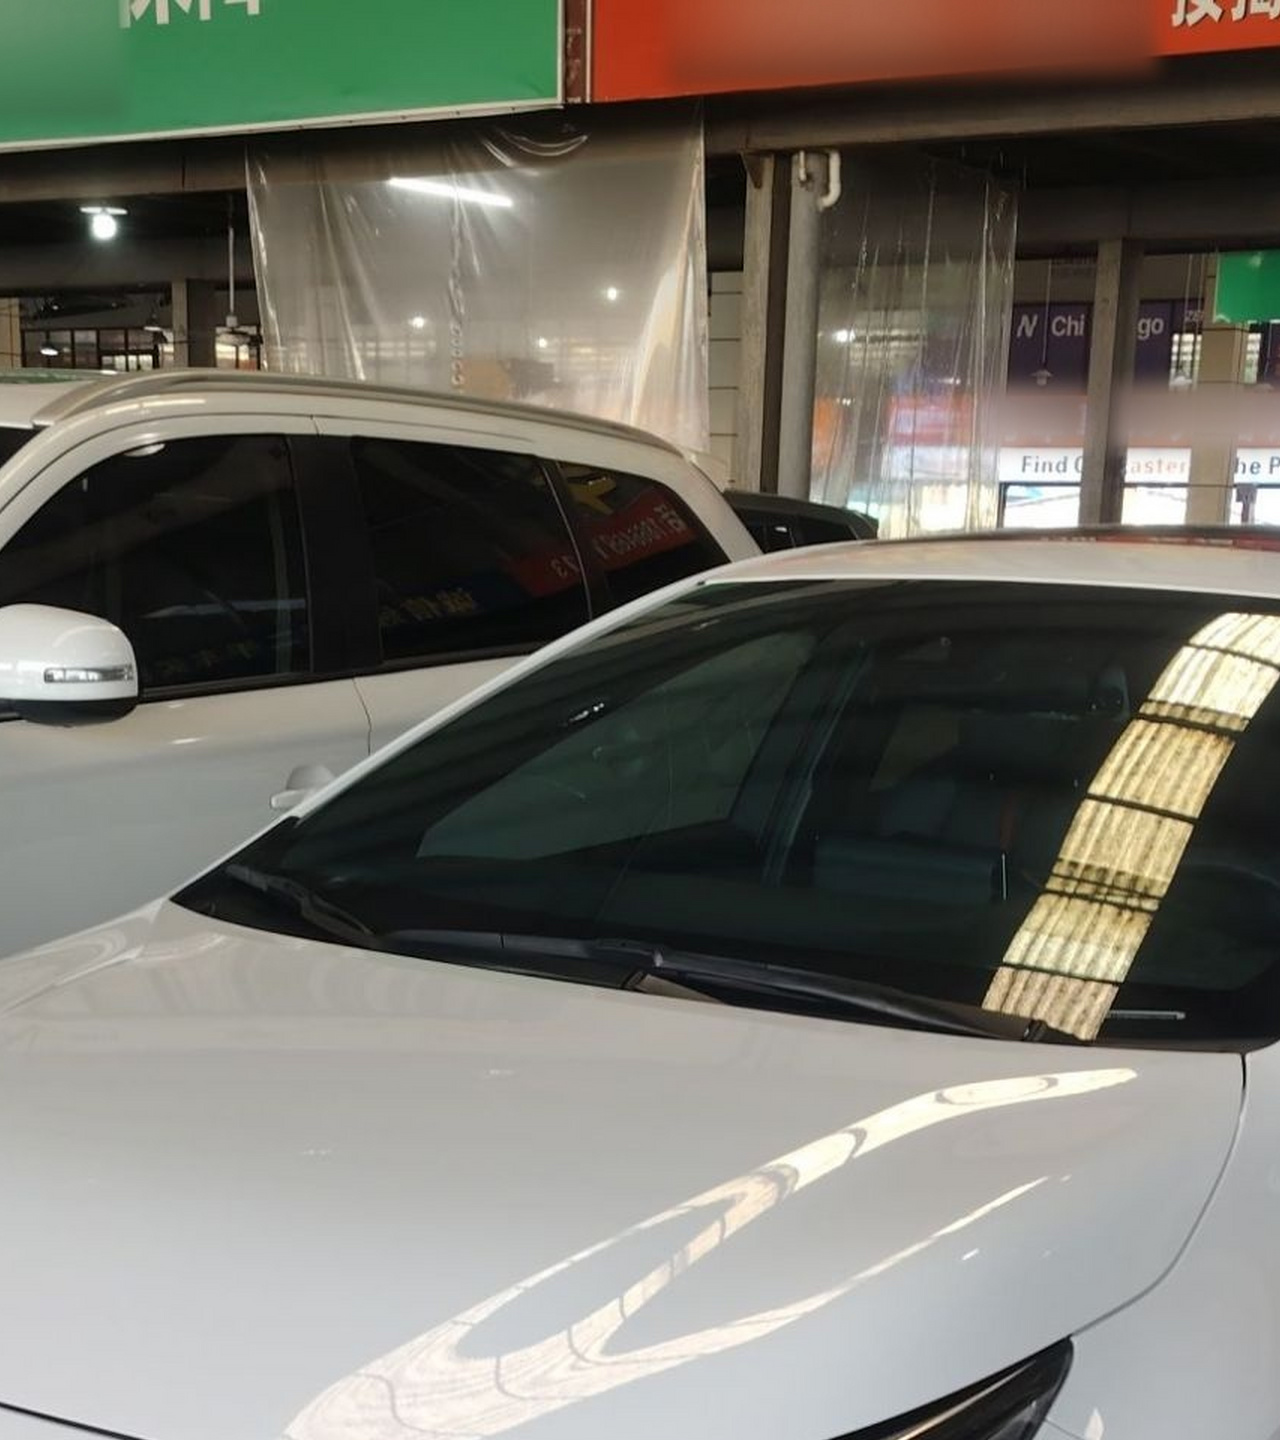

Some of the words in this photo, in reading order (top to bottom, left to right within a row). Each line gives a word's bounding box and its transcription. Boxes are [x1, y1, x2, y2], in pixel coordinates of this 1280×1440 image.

[1021, 455, 1068, 475] Find
[1130, 457, 1189, 475] aster
[1234, 455, 1262, 476] he
